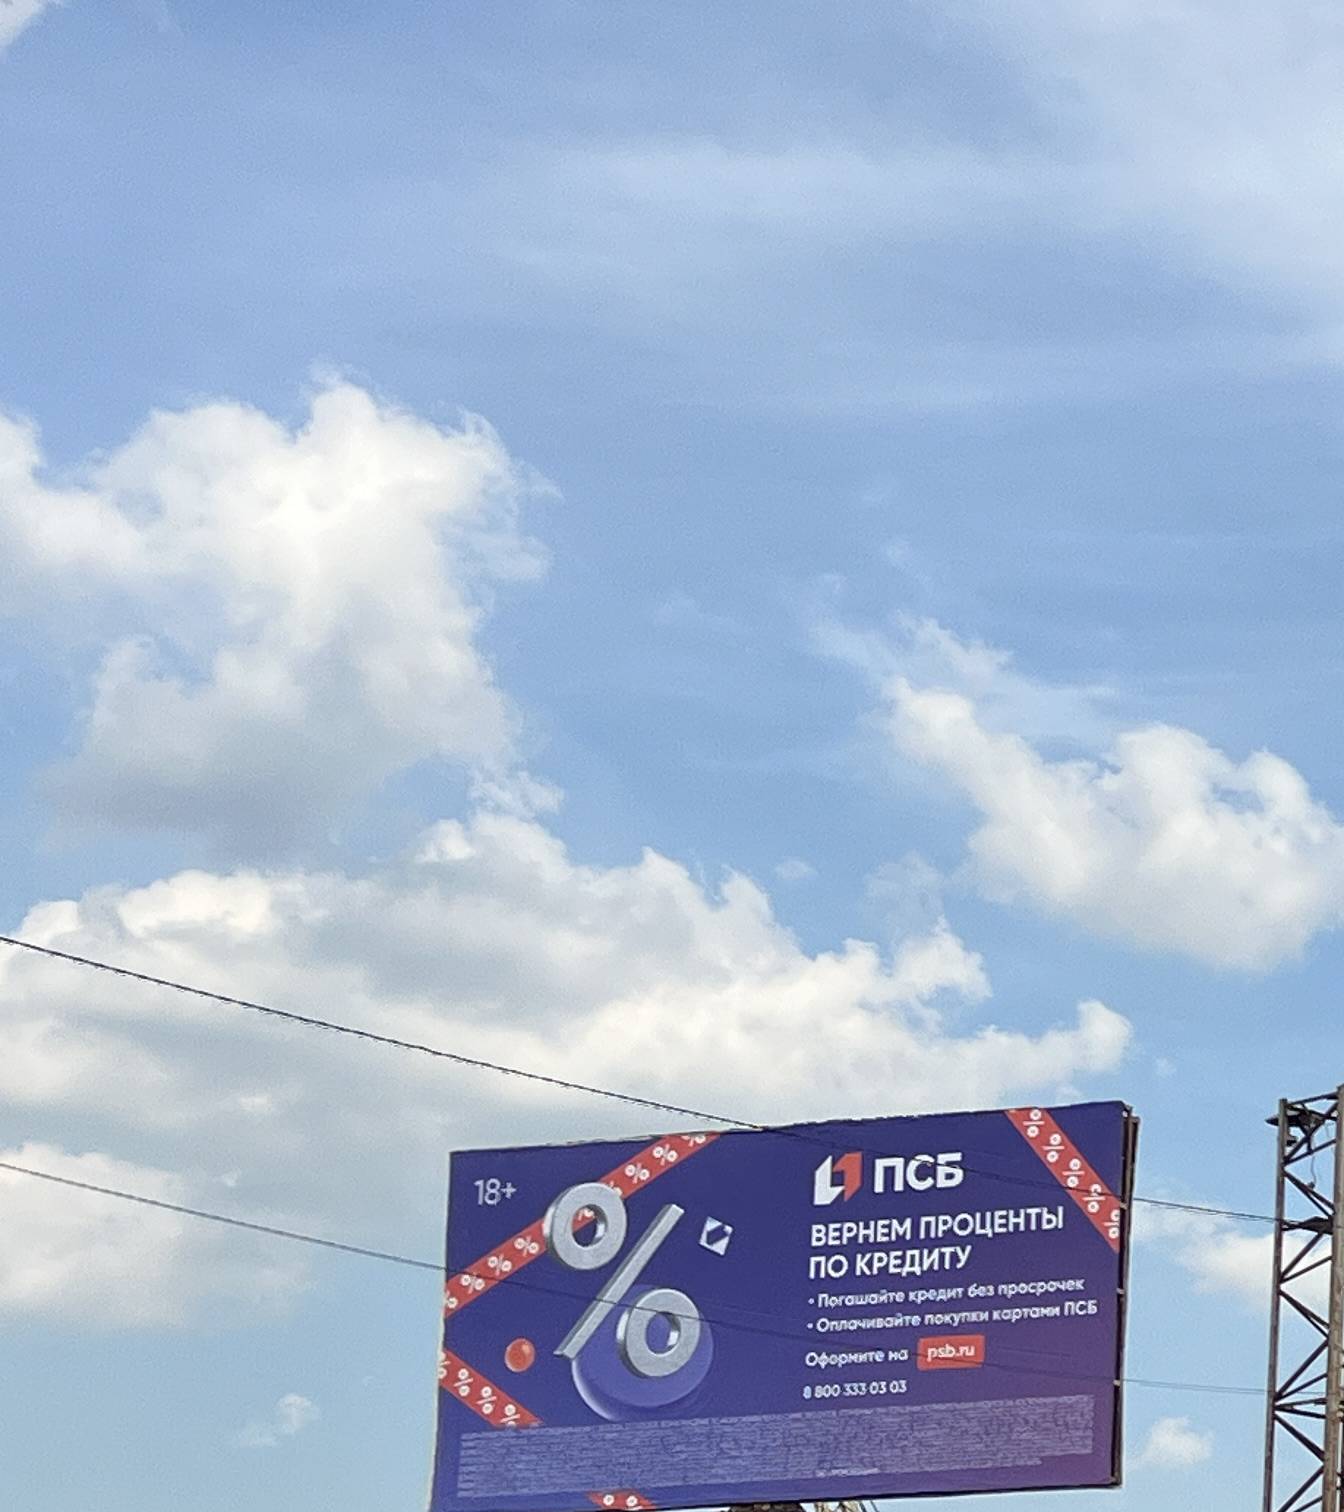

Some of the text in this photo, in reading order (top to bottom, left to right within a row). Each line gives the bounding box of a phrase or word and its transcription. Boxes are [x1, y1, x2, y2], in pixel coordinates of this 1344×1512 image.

[872, 1151, 965, 1194] ПСБ
[473, 1177, 518, 1206] 18+
[809, 1205, 1065, 1248] ВЕРНЕМ ПРОЦЕНТЫ
[808, 1245, 972, 1279] ПО КРЕДИТУ
[817, 1277, 1087, 1309] Погашайте кредит без просрочек
[815, 1299, 1099, 1333] Оплачивайте покупки картами ПСБ
[804, 1347, 909, 1369] Оформите на
[926, 1343, 976, 1361] psb.ru
[813, 1383, 841, 1397] 800
[869, 1380, 888, 1394] 03
